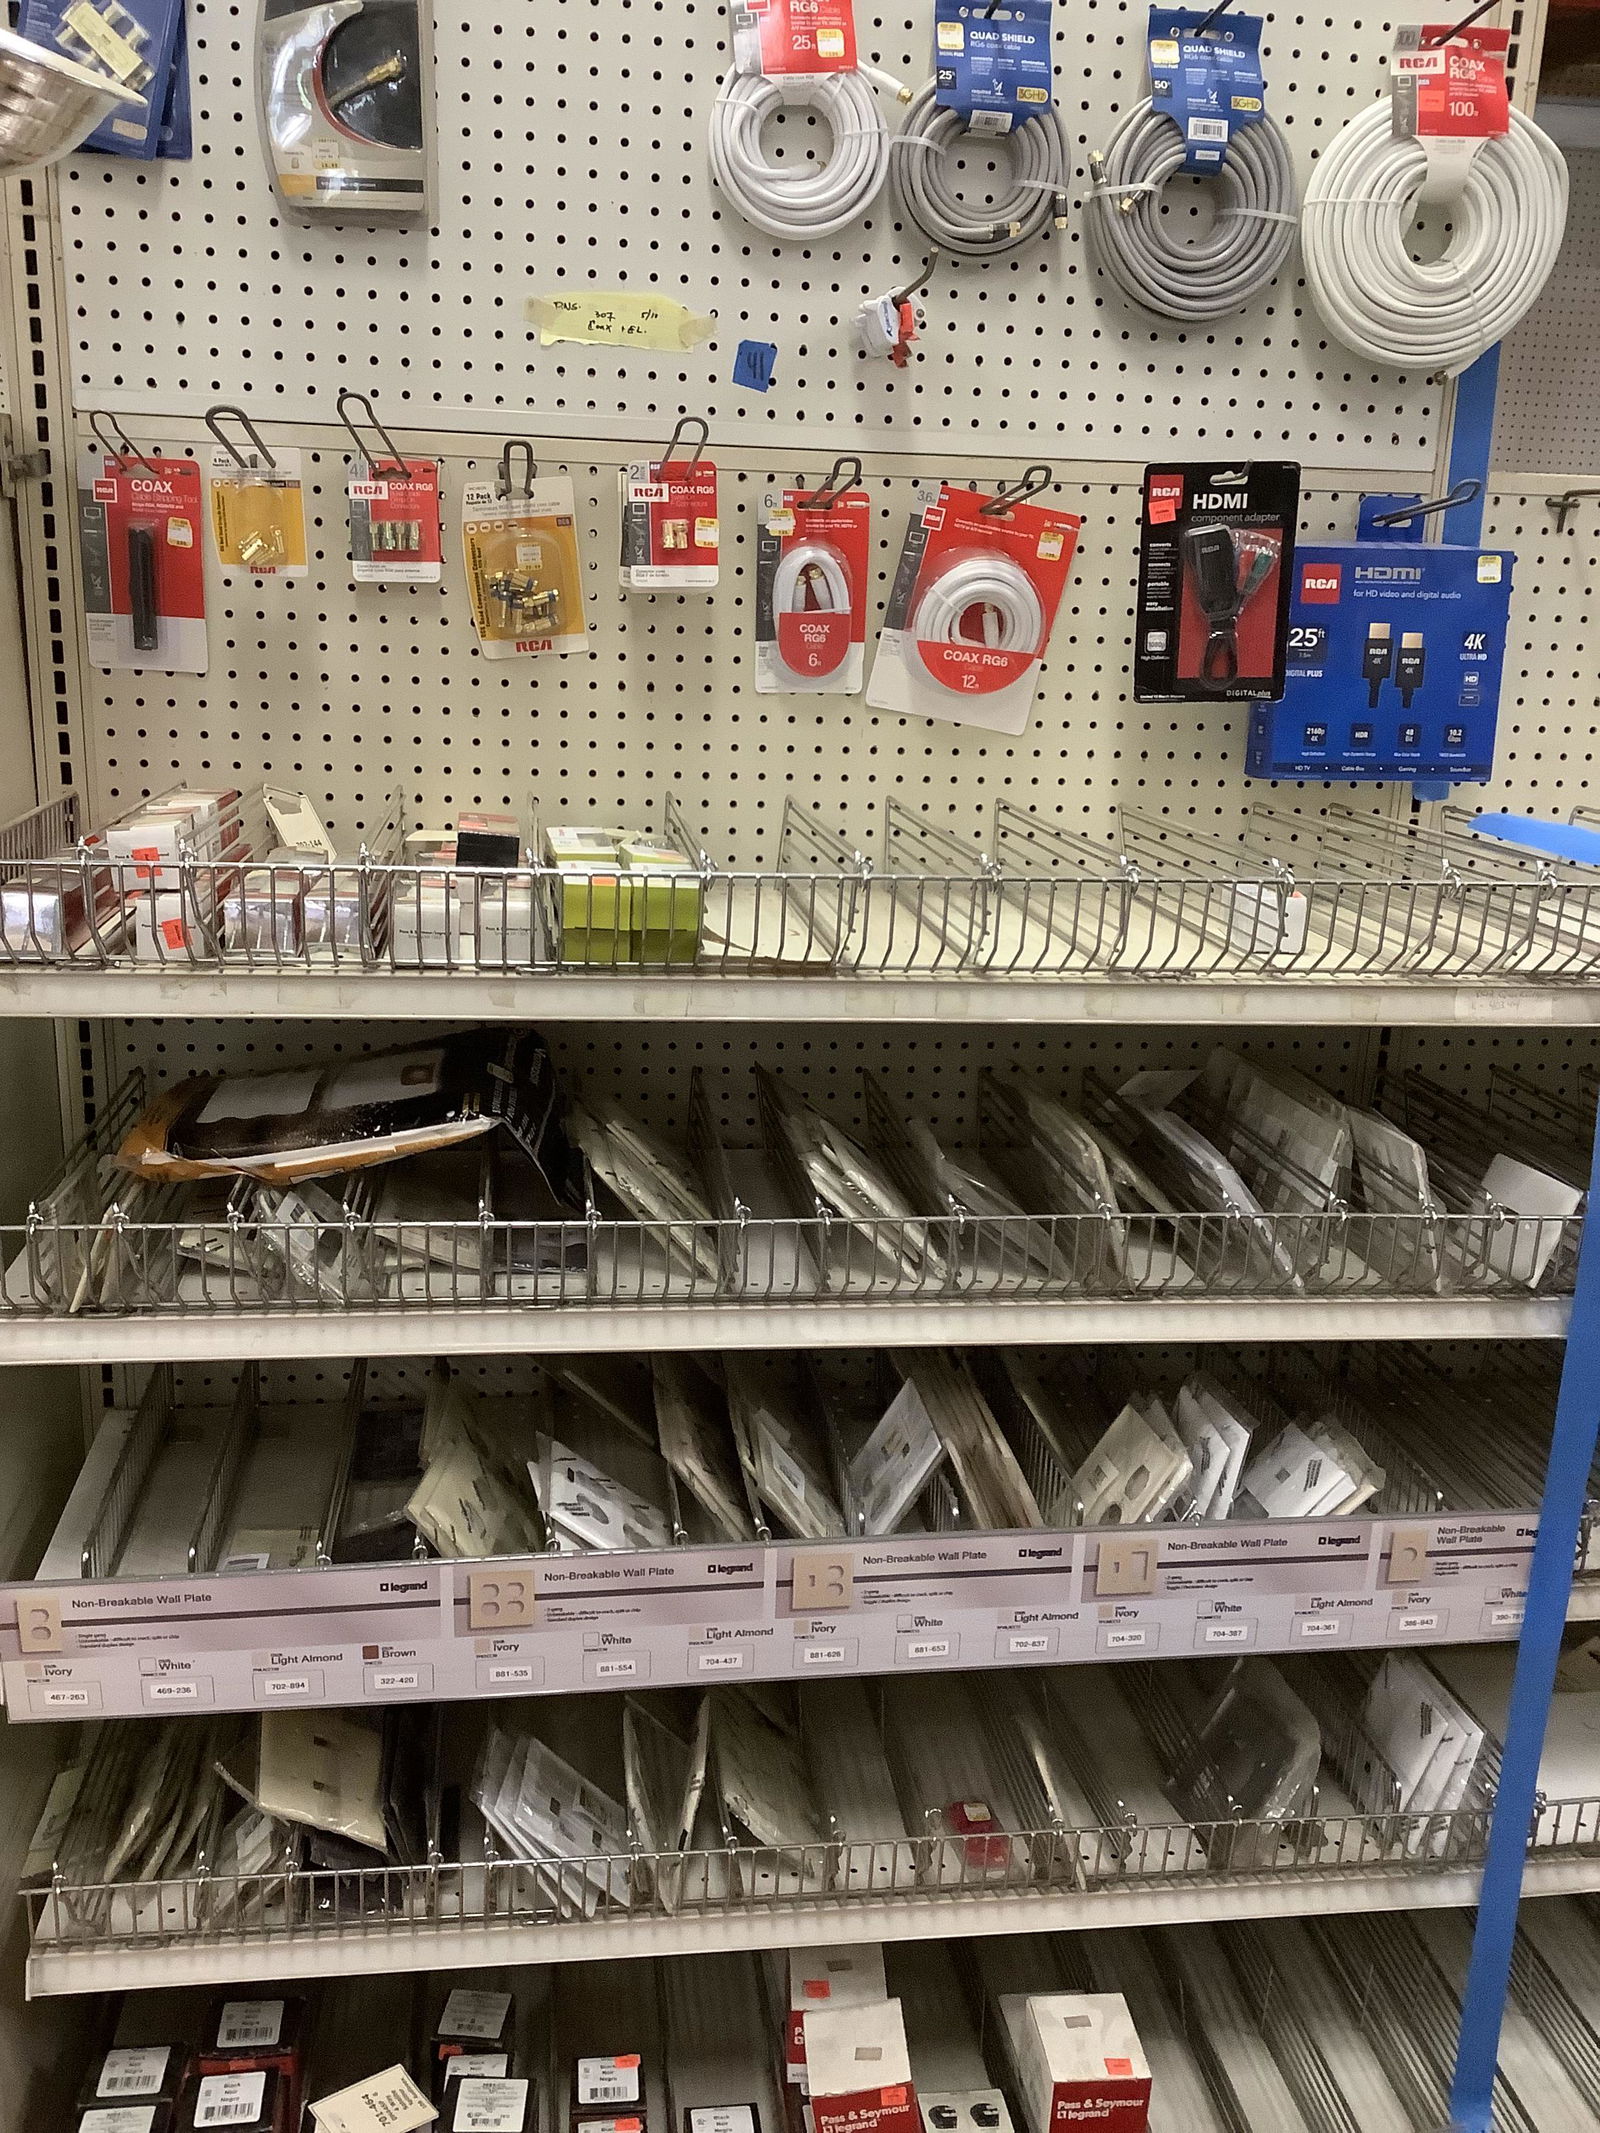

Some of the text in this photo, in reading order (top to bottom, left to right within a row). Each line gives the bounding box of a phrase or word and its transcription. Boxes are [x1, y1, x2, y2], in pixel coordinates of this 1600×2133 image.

[790, 1, 819, 13] RG6
[970, 31, 1036, 43] QUAD SHIELD
[1183, 45, 1246, 58] QUAD SHIELD
[1400, 57, 1438, 68] RCA
[1449, 55, 1486, 72] COAX
[1449, 68, 1477, 80] RG6
[594, 311, 616, 322] 307
[630, 465, 640, 480] 2
[131, 479, 173, 494] COAX
[353, 485, 383, 495] RCA
[389, 482, 434, 492] COAX RG6
[670, 485, 715, 495] COAX RG6
[476, 492, 491, 500] Pack
[633, 488, 664, 498] RCA
[1152, 488, 1181, 497] RCA
[1192, 493, 1249, 510] HDMI
[1191, 513, 1280, 524] component adapter
[1202, 545, 1220, 553] RCA
[1355, 567, 1422, 579] HDMI
[1305, 579, 1337, 589] RCA
[1353, 590, 1364, 598] for
[1366, 590, 1378, 598] HD
[1401, 591, 1415, 599] and
[1417, 591, 1439, 600] digital
[800, 624, 830, 634] COAX
[803, 634, 827, 643] RG6
[1464, 634, 1485, 650] 4K
[515, 639, 552, 653] RCA
[943, 650, 1008, 667] COAX RG6
[1478, 653, 1487, 661] HD
[1465, 675, 1477, 683] HD
[1437, 1525, 1506, 1535] Non-Breakable
[1168, 1538, 1288, 1551] Non-Breakable Wall Plate
[1328, 1535, 1361, 1547] legrand
[1437, 1535, 1482, 1544] Wall Plate
[863, 1551, 987, 1565] Non-Breakable Wall Plate
[1028, 1548, 1062, 1560] legrand
[544, 1568, 675, 1582] Non-Breakable Wall Plate
[717, 1563, 753, 1576] legrand
[390, 1581, 428, 1593] legrand
[72, 1594, 212, 1608] Non-Breakable Wall Plate
[1311, 1598, 1374, 1609] Light Almond
[1408, 1596, 1431, 1605] Ivory
[1115, 1609, 1140, 1619] Ivory
[1214, 1604, 1242, 1613] White
[914, 1618, 943, 1628] White
[1014, 1612, 1079, 1624] Light Almond
[706, 1628, 774, 1641] Light Almond
[811, 1624, 837, 1634] Ivory
[601, 1636, 632, 1645] White
[493, 1643, 520, 1653] Ivory
[382, 1649, 416, 1659] Brown
[159, 1661, 191, 1670] White
[271, 1653, 343, 1667] Light Almond
[705, 1657, 737, 1666] 704-437
[44, 1667, 73, 1678] Ivory
[495, 1670, 528, 1678] 881-535
[600, 1664, 633, 1673] 881-554
[271, 1682, 306, 1691] 702-894
[380, 1677, 414, 1685] 322-420
[1057, 2098, 1144, 2112] Pass & Seymour
[820, 2103, 910, 2126] Pass & Seymour
[1066, 2109, 1110, 2121] legrand
[834, 2118, 878, 2133] legrand
